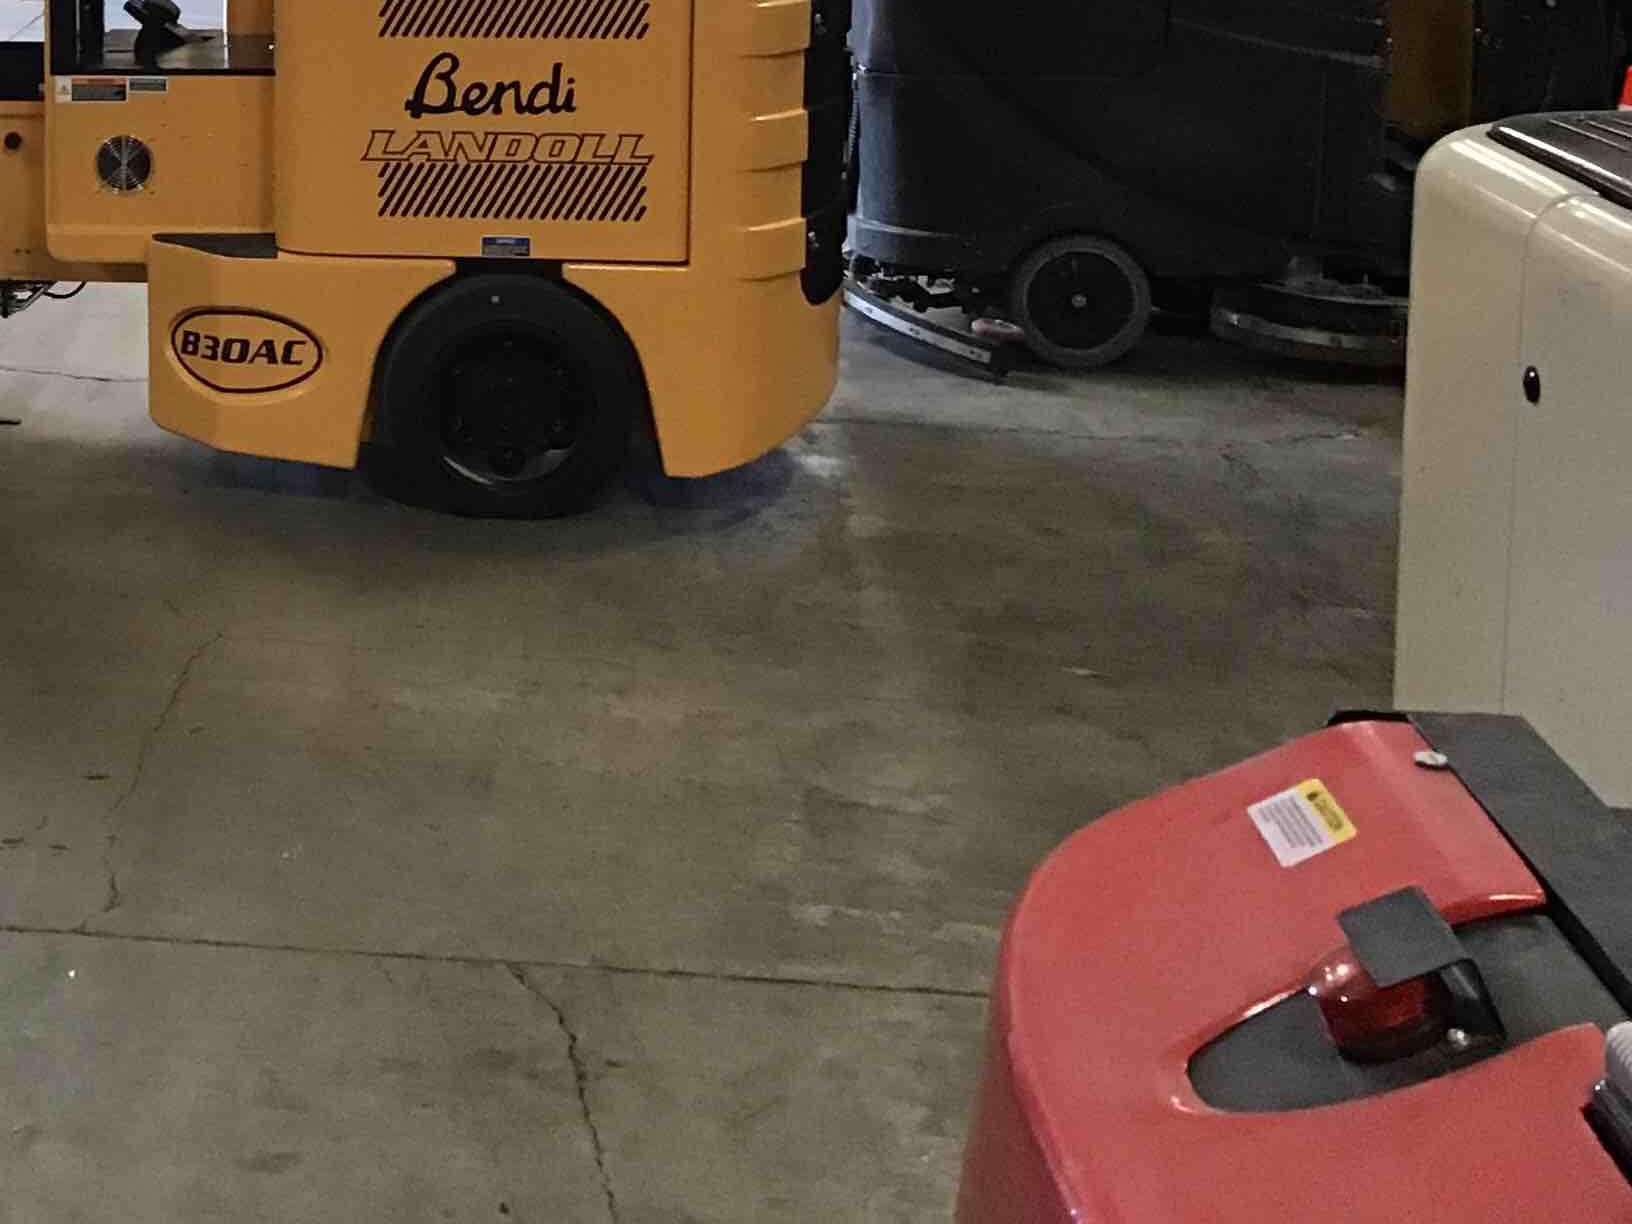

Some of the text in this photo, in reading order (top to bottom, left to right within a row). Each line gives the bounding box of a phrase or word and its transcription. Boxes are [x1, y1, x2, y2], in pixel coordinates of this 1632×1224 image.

[403, 51, 577, 120] Bendi
[360, 129, 655, 166] LANDOLL
[180, 330, 307, 365] B30AC
